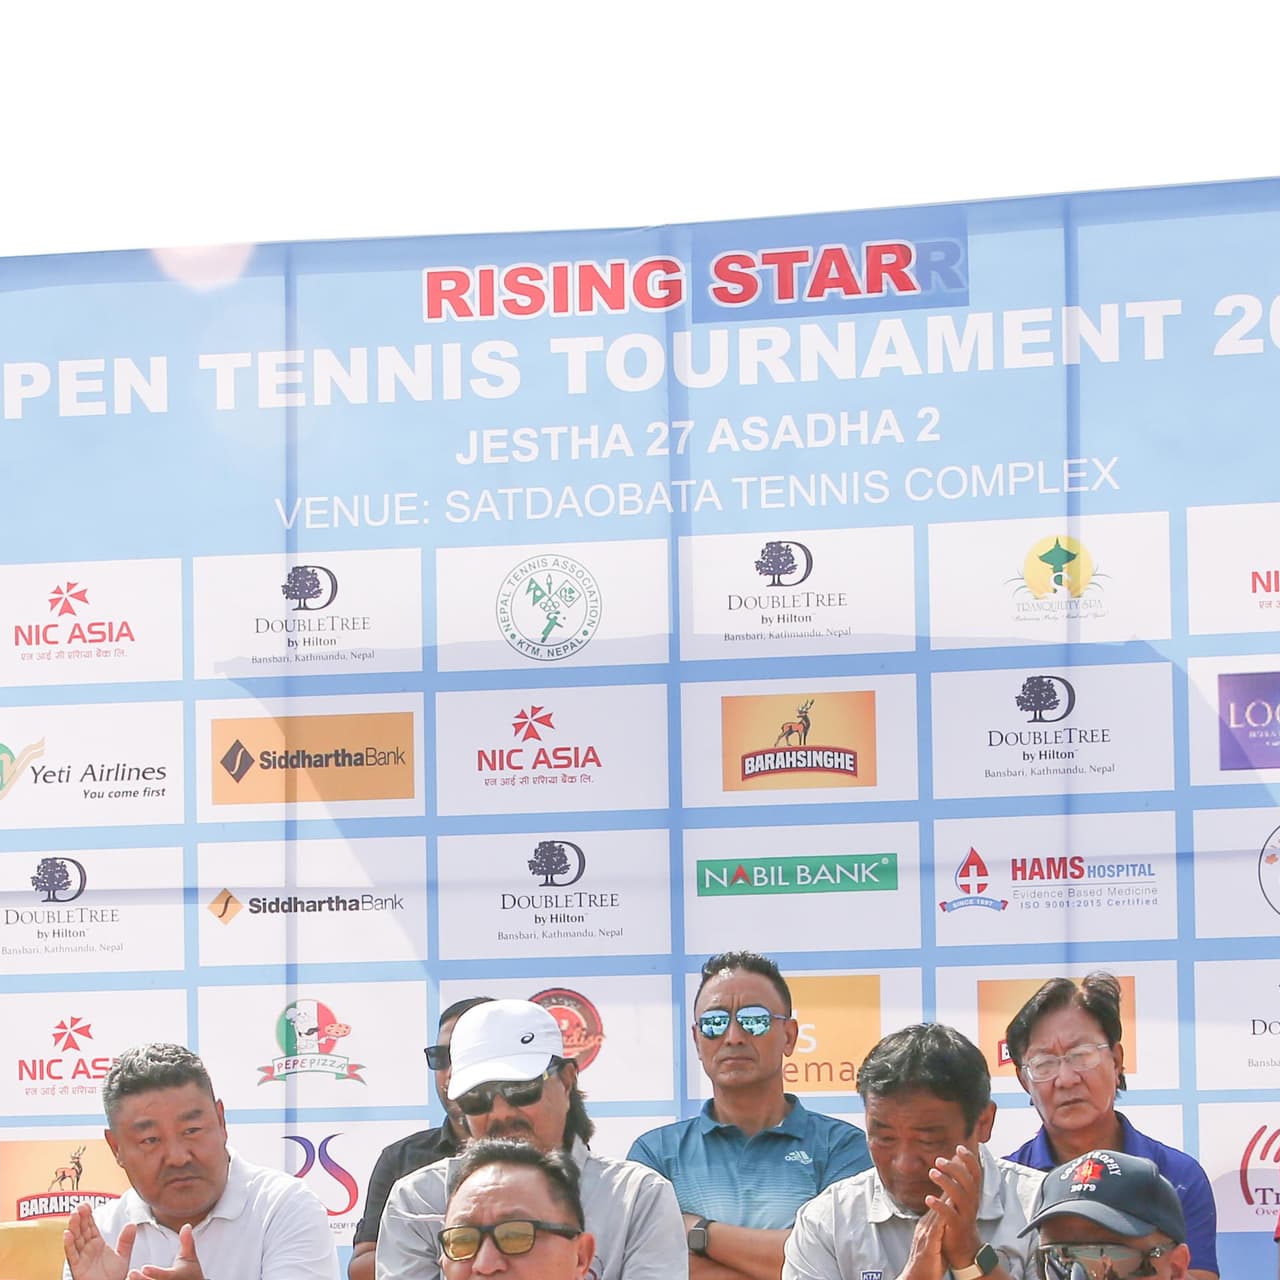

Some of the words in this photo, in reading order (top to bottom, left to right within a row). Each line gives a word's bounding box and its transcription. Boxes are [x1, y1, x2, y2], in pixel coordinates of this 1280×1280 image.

[422, 256, 685, 322] RISING
[198, 340, 522, 411] TENNIS
[549, 299, 1182, 395] TOURNAMENT
[456, 424, 634, 466] JESTHA
[646, 420, 691, 457] 27
[707, 408, 905, 453] ASADHA
[916, 406, 941, 443] 2
[274, 492, 431, 531] VENUE:
[444, 477, 723, 524] SATDAOBATA
[731, 469, 891, 511] TENNIS
[904, 455, 1122, 502] COMPLEX
[499, 591, 512, 632] NEPAL
[507, 558, 548, 587] TENNIS
[552, 558, 599, 628] ASSOCIATION
[761, 614, 773, 626] by
[776, 612, 812, 624] Hilton
[14, 623, 59, 647] NIC
[67, 620, 136, 645] ASIA
[825, 627, 852, 640] Nepal
[287, 637, 299, 649] by
[302, 635, 337, 647] Hilton
[547, 638, 584, 657] NEPAL
[350, 650, 375, 662] Nepal
[477, 748, 523, 771] NIC
[531, 745, 603, 770] ASIA
[744, 749, 855, 775] BARAHSINGHE
[1022, 750, 1035, 762] by
[1038, 748, 1075, 760] Hilton
[30, 764, 71, 785] Yeti
[80, 762, 167, 783] Airlines
[1089, 764, 1115, 776] Nepal
[82, 789, 102, 800] You
[106, 789, 138, 799] come
[141, 786, 167, 798] first
[705, 863, 790, 888] NABIL
[796, 861, 880, 885] BANK
[1011, 856, 1085, 881] HAMS
[1087, 864, 1156, 878] HOSPITAL
[1013, 889, 1063, 899] Evidence
[1067, 887, 1103, 898] Based
[1107, 887, 1158, 896] Medicine
[1020, 901, 1040, 910] ISO
[1106, 898, 1158, 906] Certified
[534, 913, 547, 925] by
[550, 911, 584, 923] Hilton
[37, 929, 49, 940] by
[52, 926, 86, 938] Hilton
[598, 927, 623, 939] Nepal
[98, 942, 123, 953] Nepal
[18, 1058, 63, 1081] NIC
[71, 1057, 112, 1080] AS
